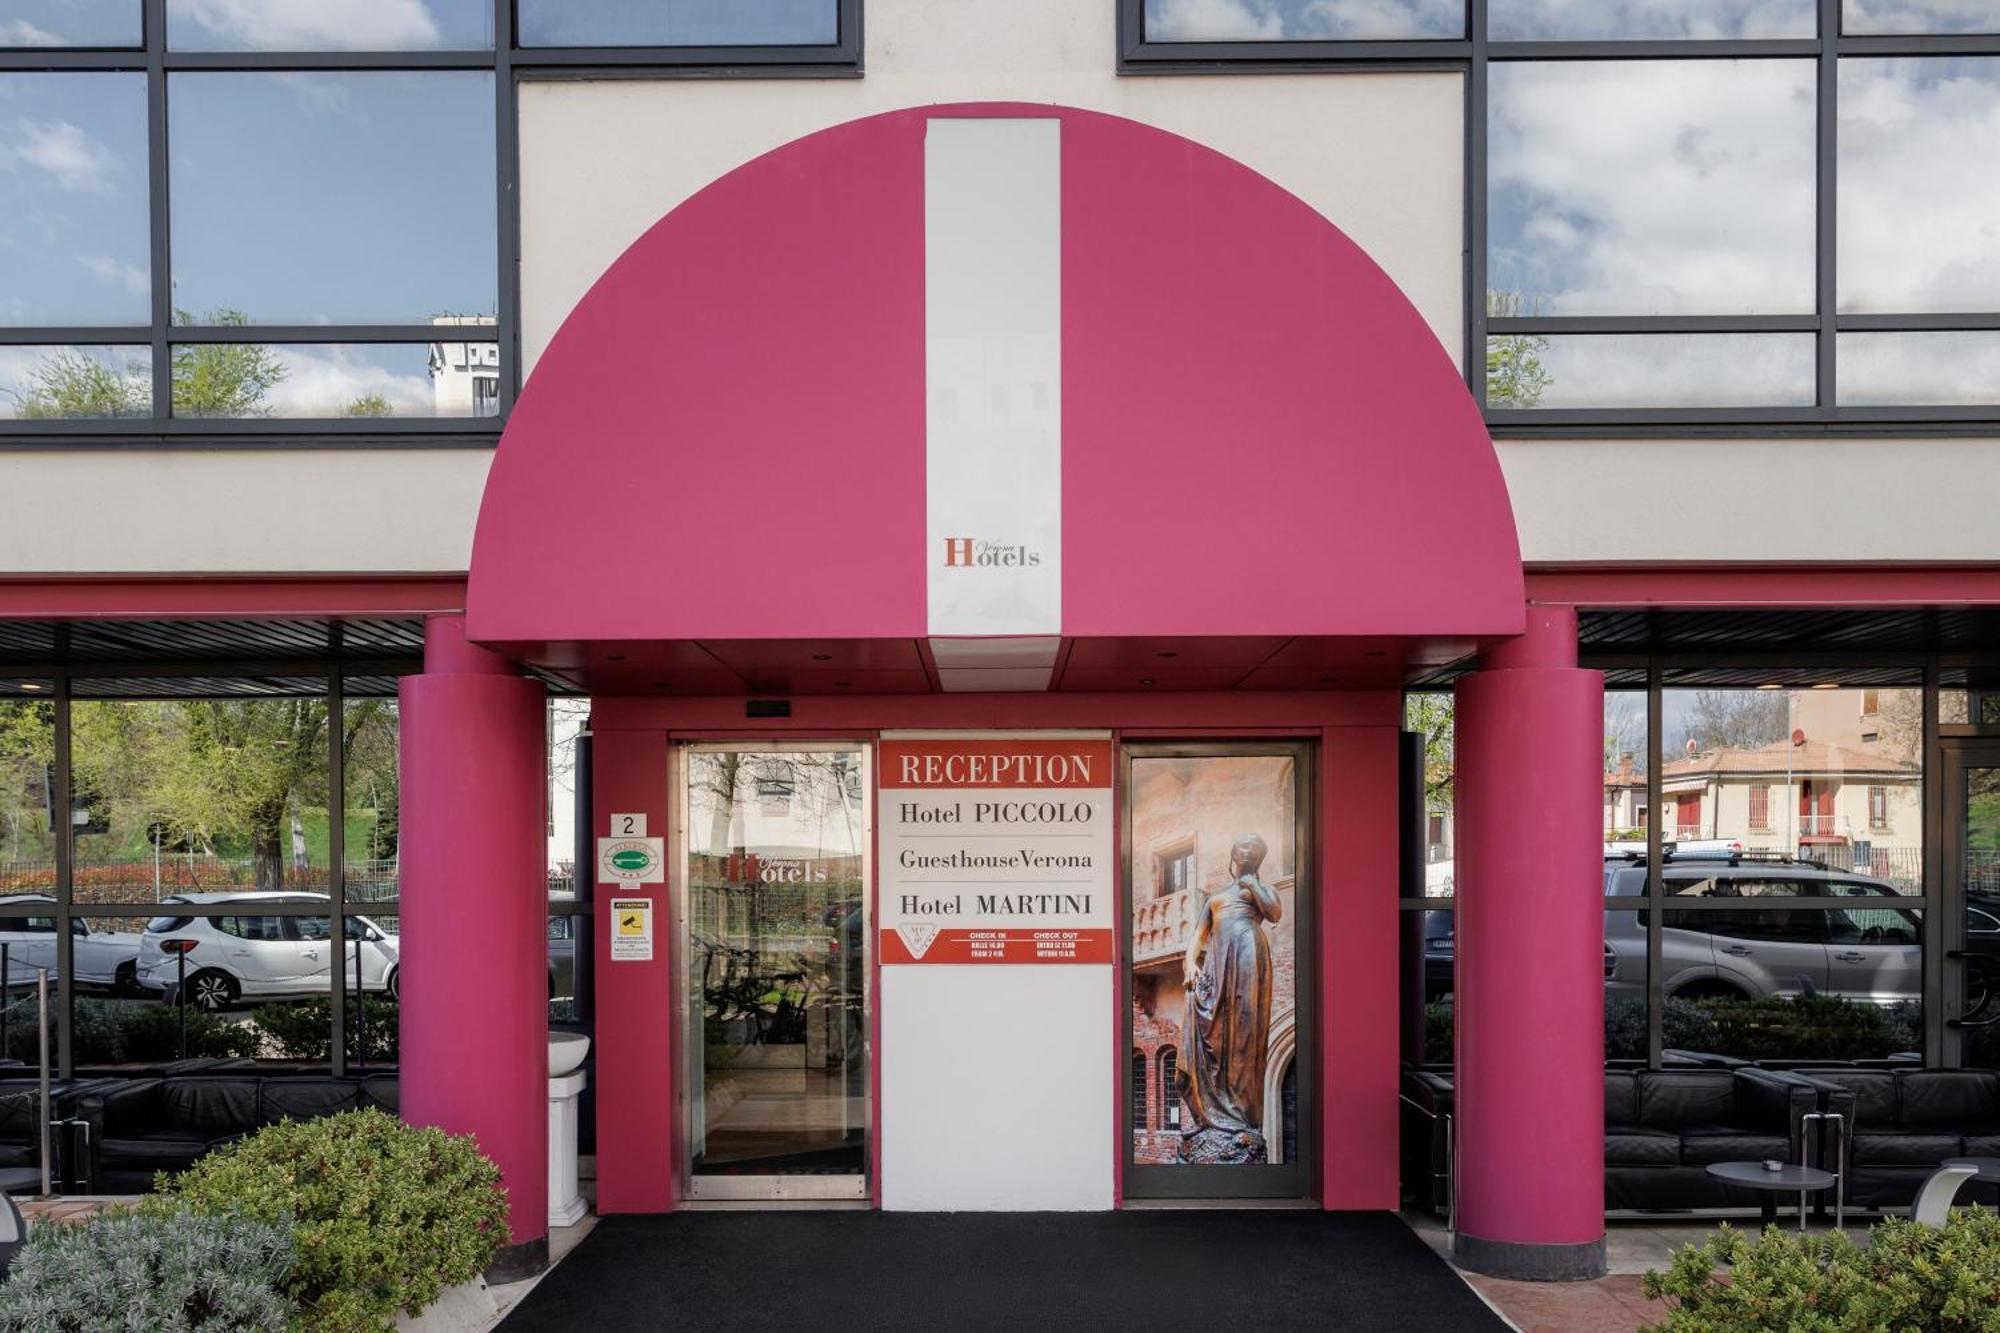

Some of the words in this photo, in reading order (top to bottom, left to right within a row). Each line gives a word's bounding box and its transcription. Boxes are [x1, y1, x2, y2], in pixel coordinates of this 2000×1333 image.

[943, 537, 1040, 567] Hotels
[899, 755, 1093, 784] RECEPTION
[623, 816, 634, 834] 2
[899, 803, 961, 823] Hotel
[974, 802, 1092, 823] PICCOLO
[727, 853, 828, 884] Hotels
[899, 895, 961, 915] Hotel
[976, 894, 1092, 915] MARTINI
